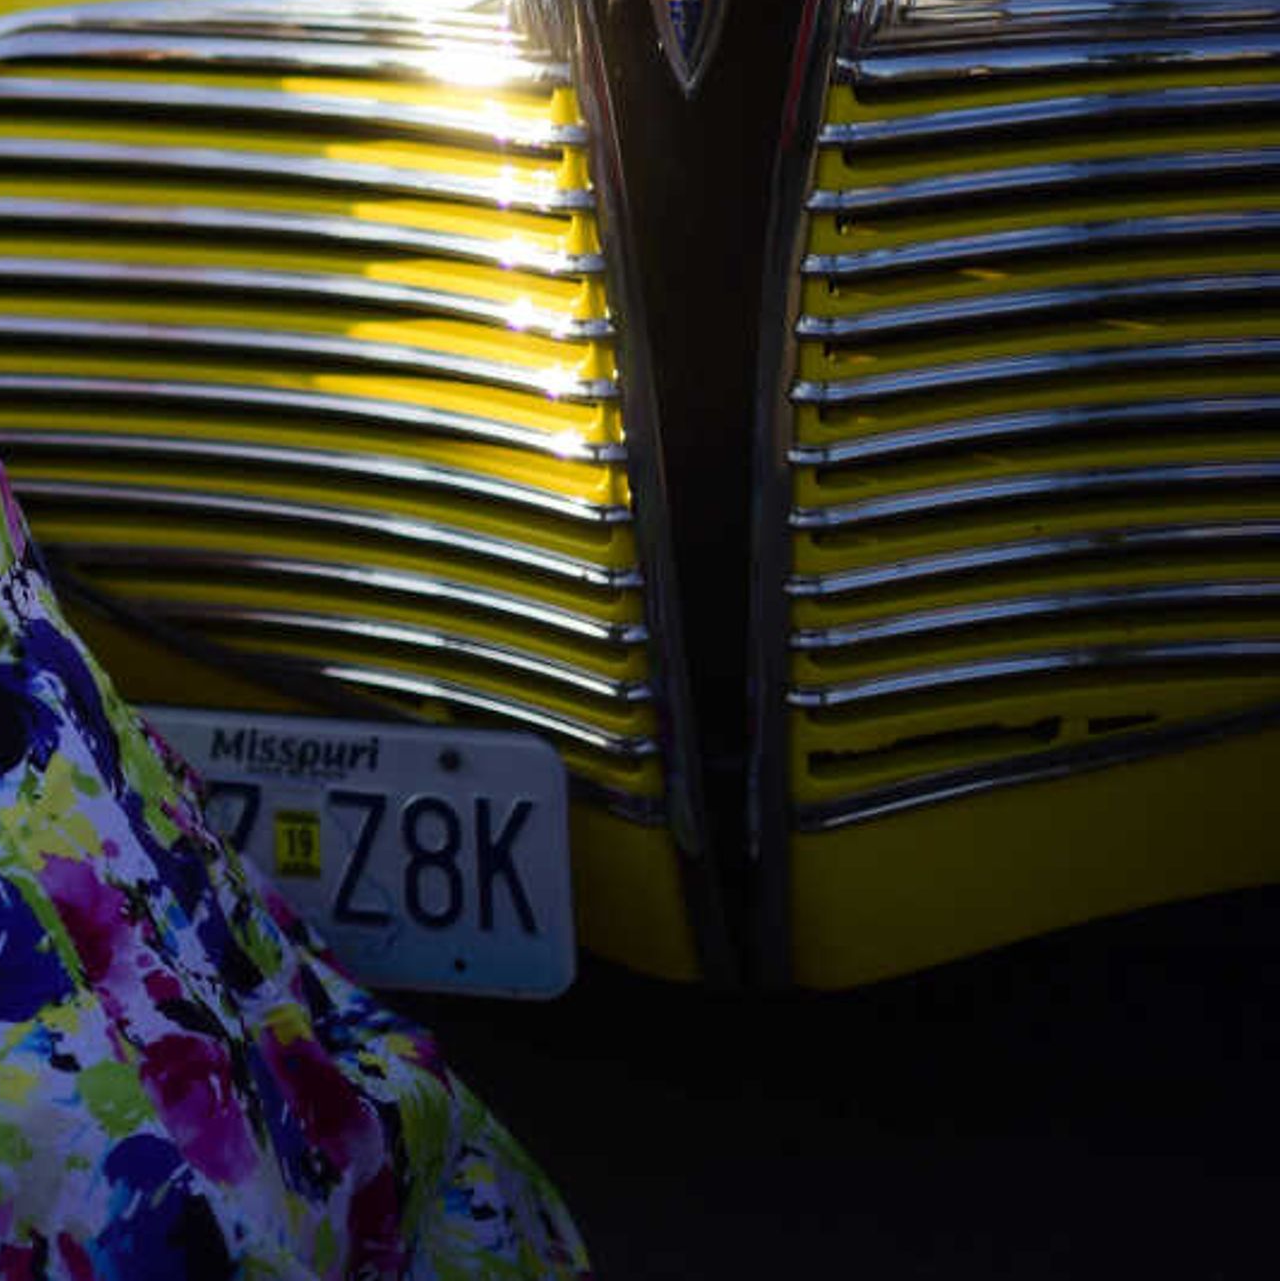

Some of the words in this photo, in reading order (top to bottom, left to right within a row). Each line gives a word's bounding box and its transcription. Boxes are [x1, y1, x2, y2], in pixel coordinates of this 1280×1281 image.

[209, 727, 379, 772] Missouri
[282, 827, 314, 859] 19
[328, 789, 537, 934] Z8K
